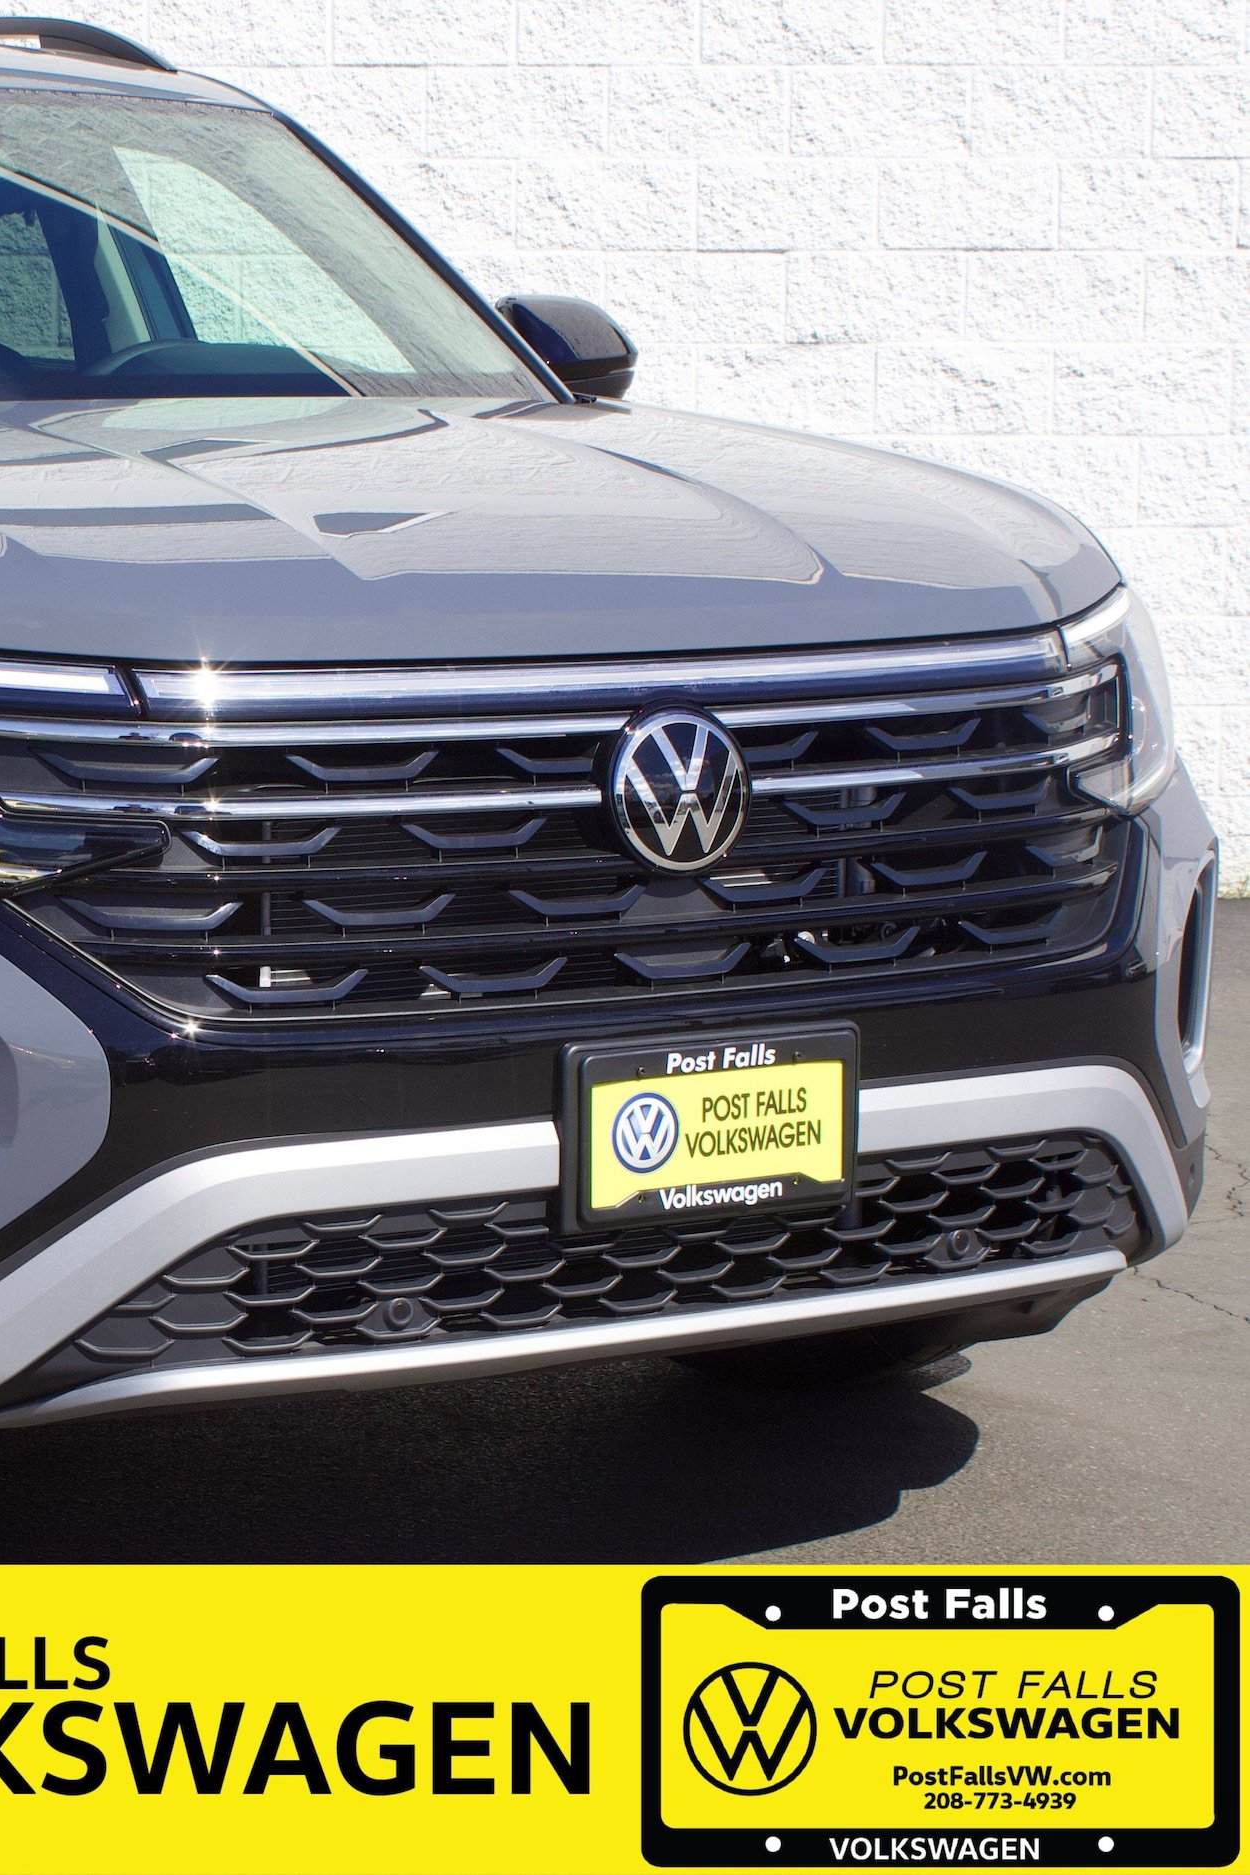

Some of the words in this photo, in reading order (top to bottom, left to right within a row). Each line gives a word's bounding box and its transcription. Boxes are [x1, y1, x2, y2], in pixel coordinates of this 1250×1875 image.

[666, 1051, 716, 1075] Post
[722, 1043, 776, 1069] Falls
[702, 1093, 751, 1123] POST
[756, 1087, 807, 1117] FALLS
[685, 1119, 822, 1158] VOLKSWAGEN
[659, 1180, 783, 1210] Volkswagen
